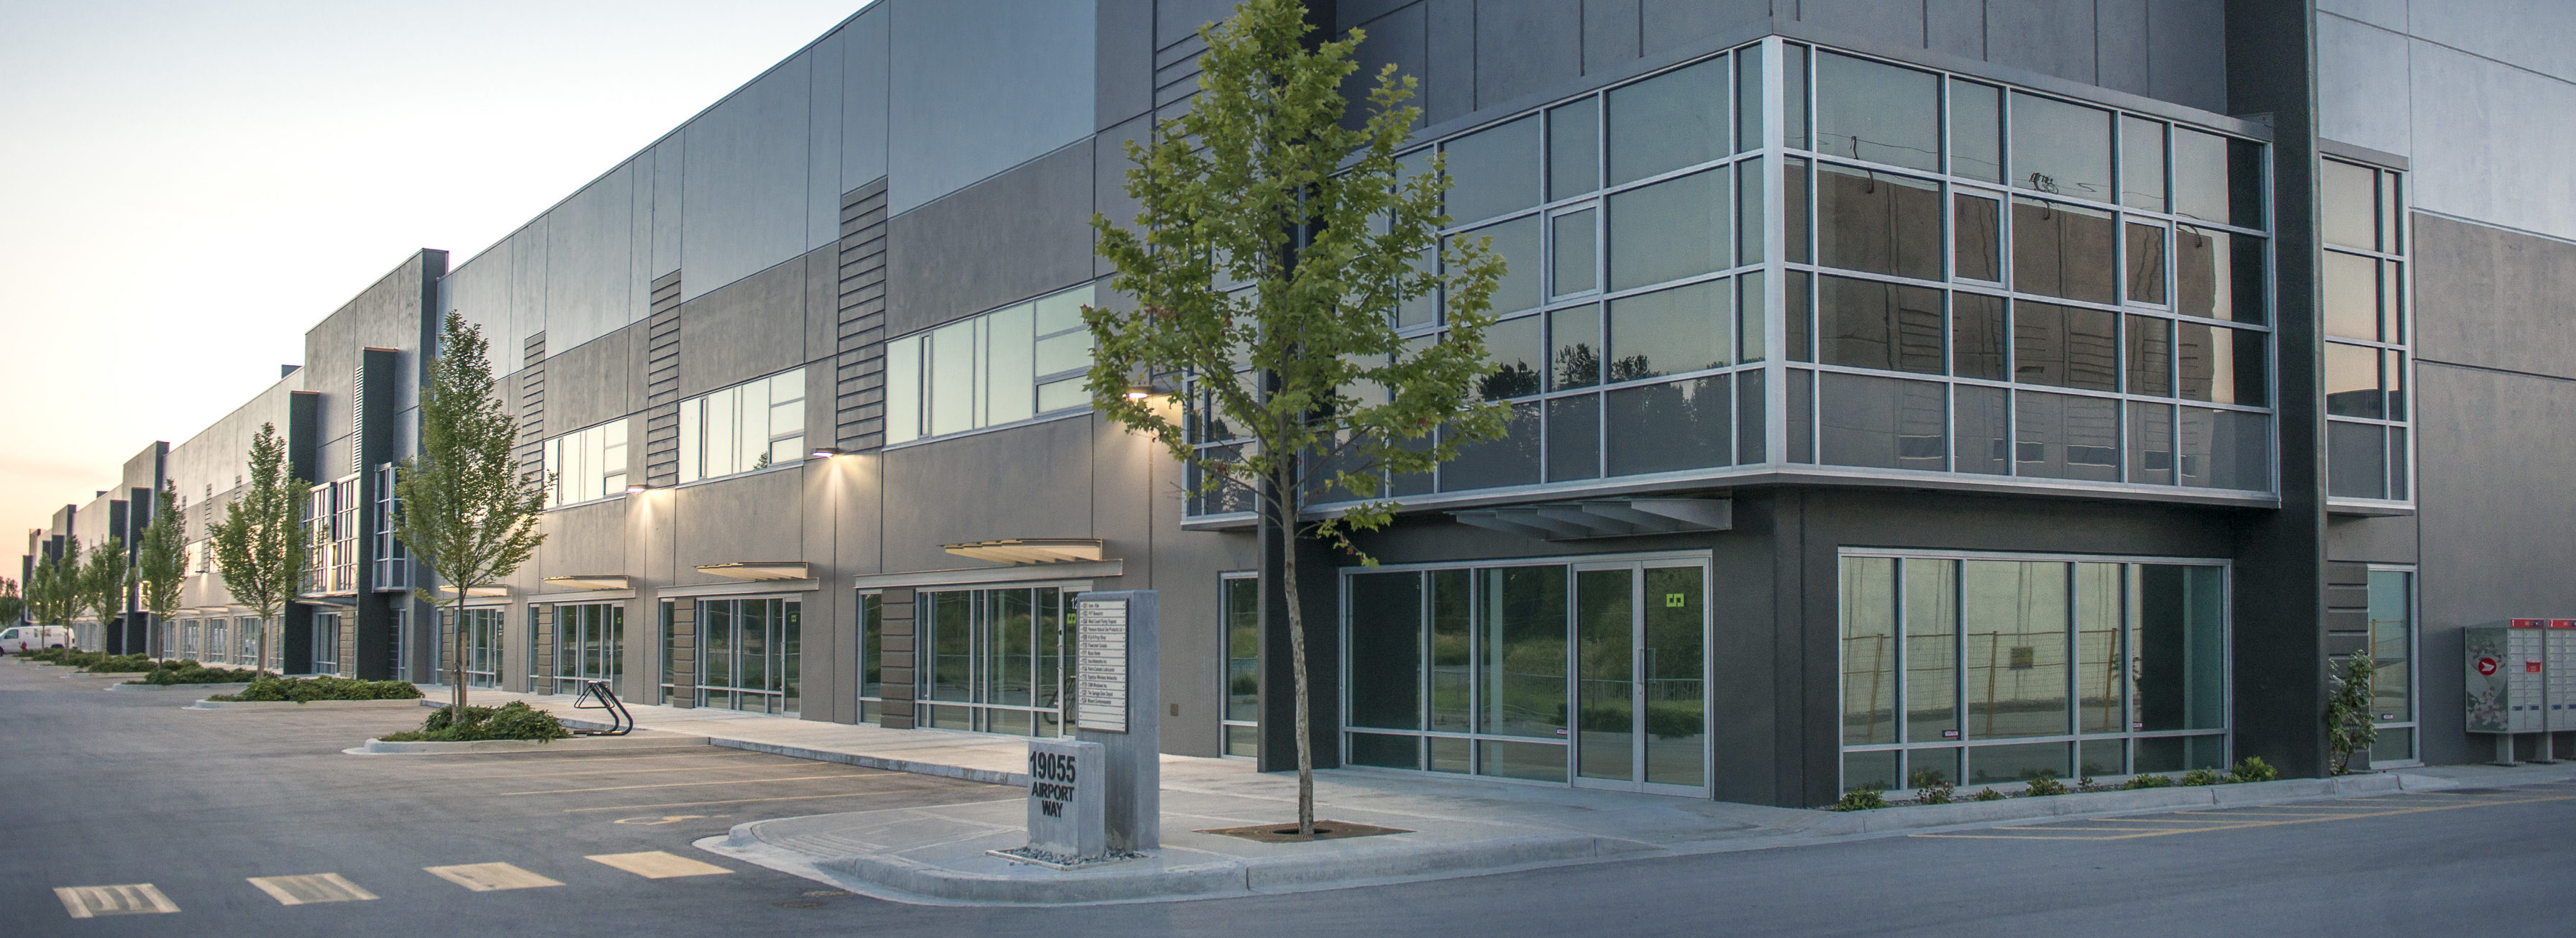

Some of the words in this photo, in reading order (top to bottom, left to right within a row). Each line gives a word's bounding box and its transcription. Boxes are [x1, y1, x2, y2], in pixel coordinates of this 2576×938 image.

[1030, 750, 1076, 783] 19055
[1032, 781, 1074, 801] AIRPORT
[1042, 800, 1063, 818] WAY
